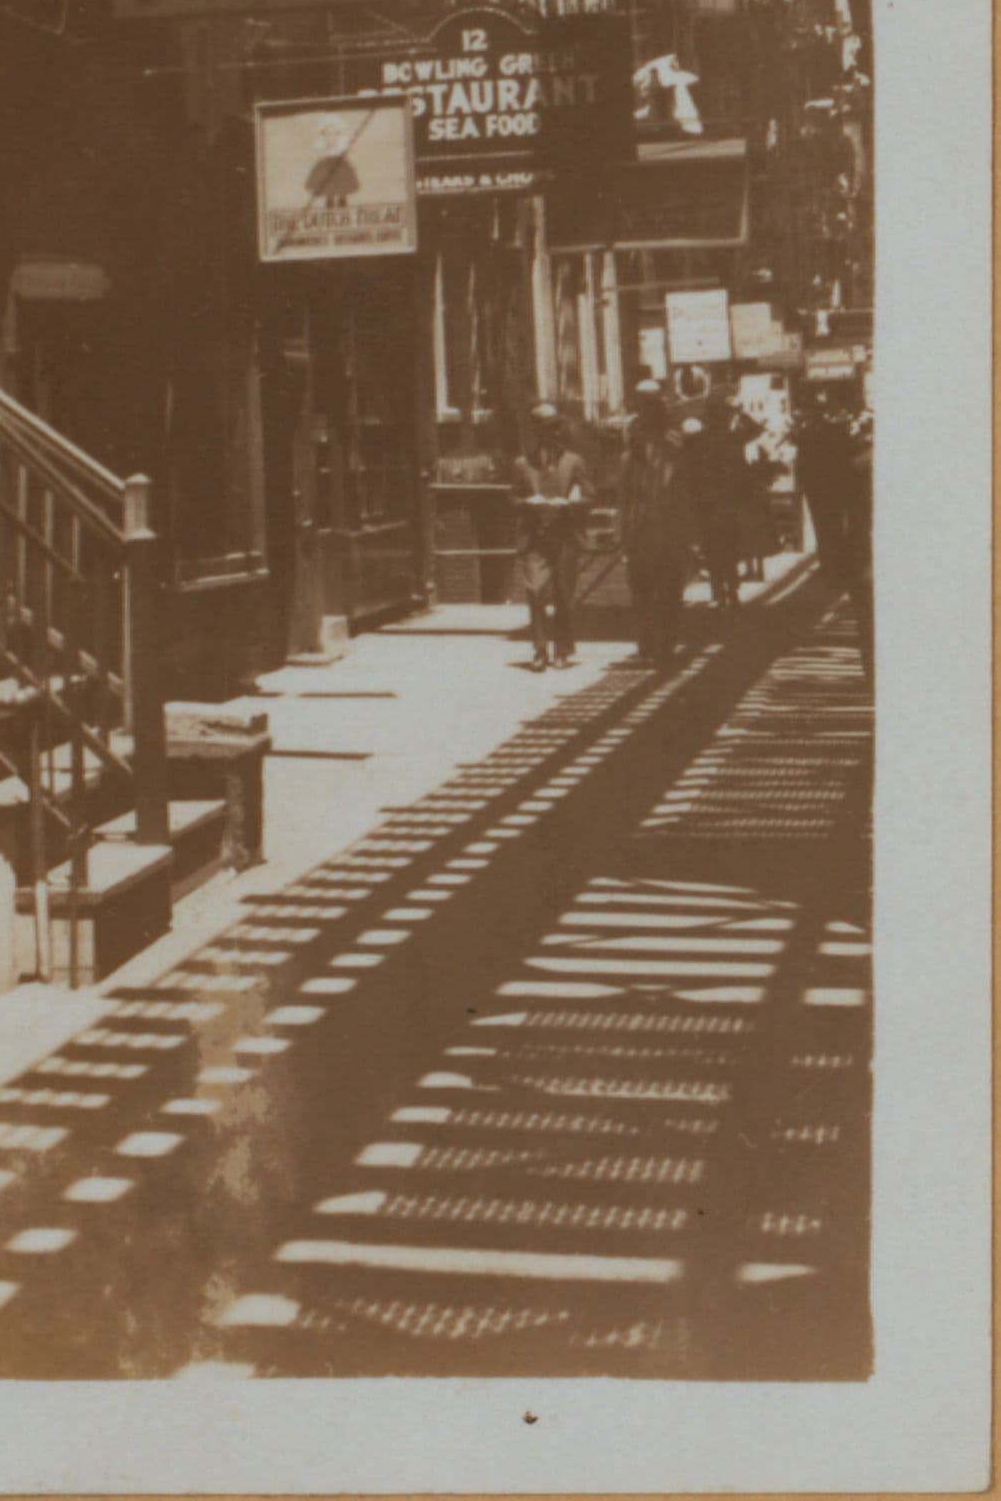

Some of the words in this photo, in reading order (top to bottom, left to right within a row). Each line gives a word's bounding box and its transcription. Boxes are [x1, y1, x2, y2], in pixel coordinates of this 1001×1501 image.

[461, 29, 489, 52] 12
[382, 56, 488, 84] BOWLING
[356, 74, 600, 117] STAURANT
[427, 116, 481, 142] SEA
[485, 112, 542, 138] FOOD
